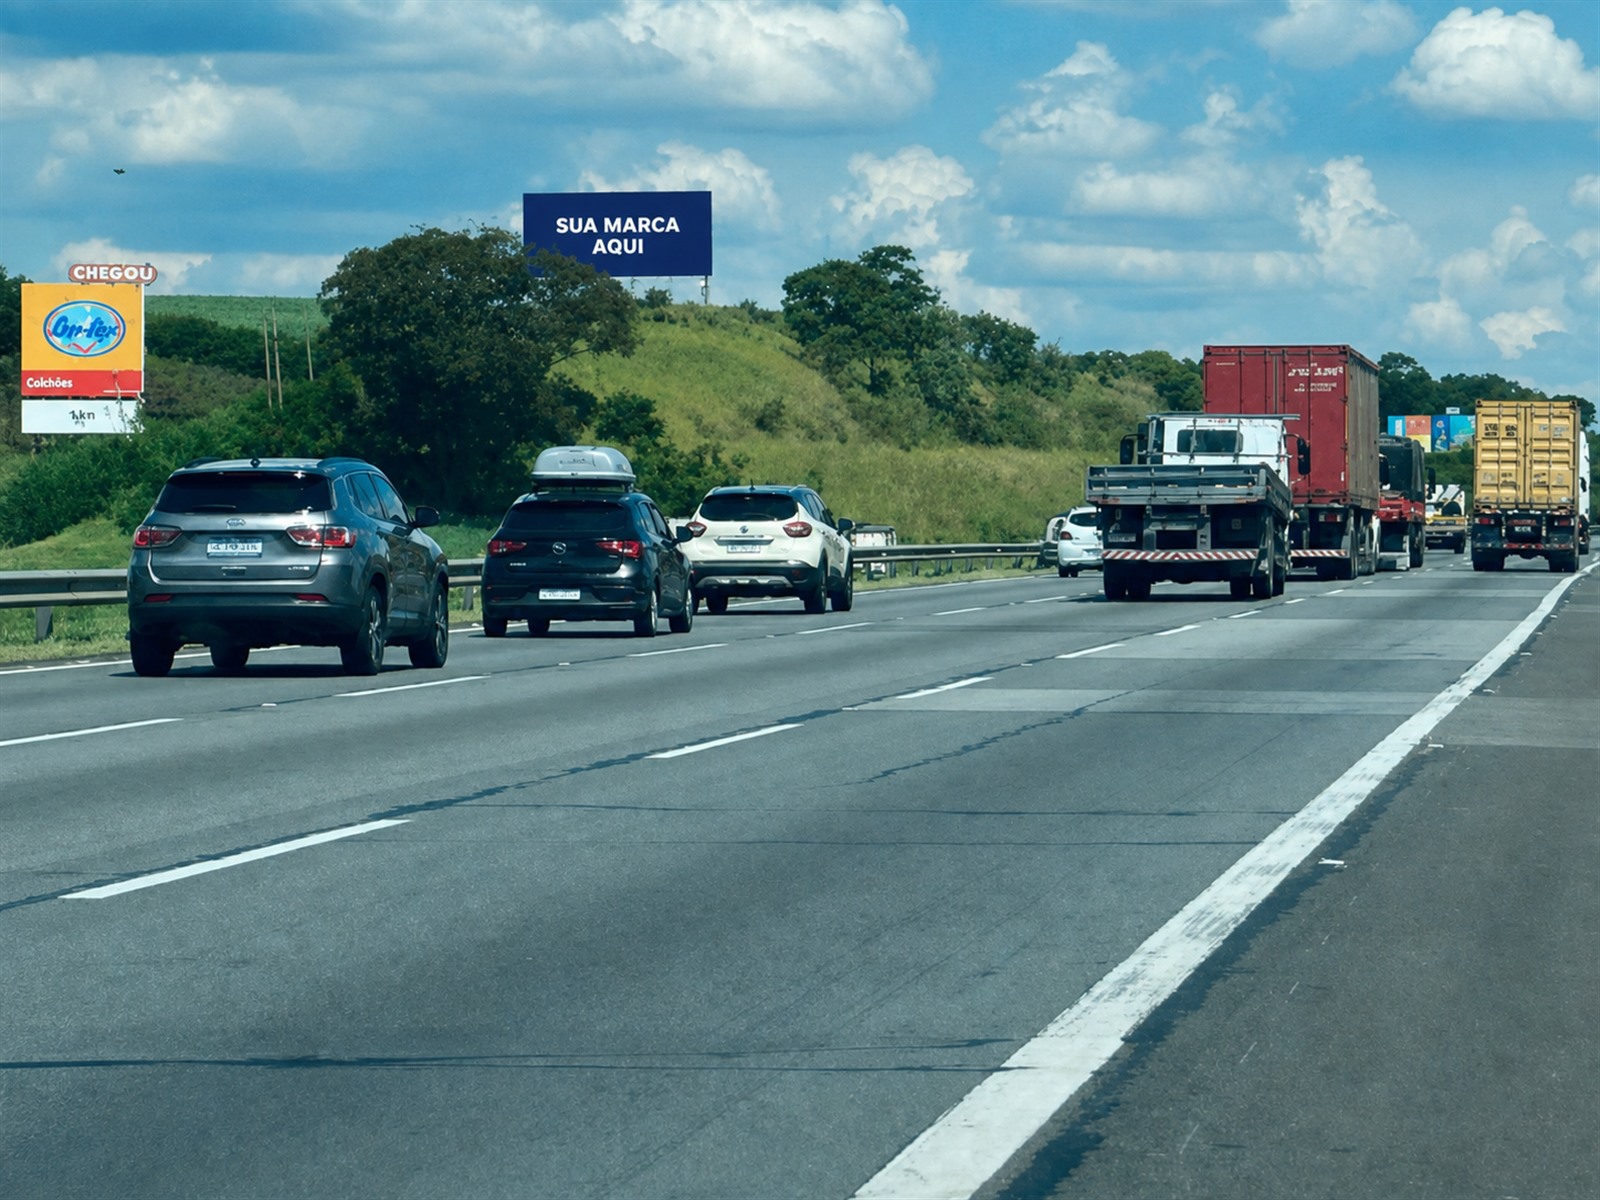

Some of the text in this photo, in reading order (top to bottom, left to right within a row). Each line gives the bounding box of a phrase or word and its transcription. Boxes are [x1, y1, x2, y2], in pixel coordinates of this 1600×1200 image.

[556, 217, 680, 234] SUA MARCA
[592, 239, 644, 255] AQUI
[73, 266, 153, 280] CHEGOU
